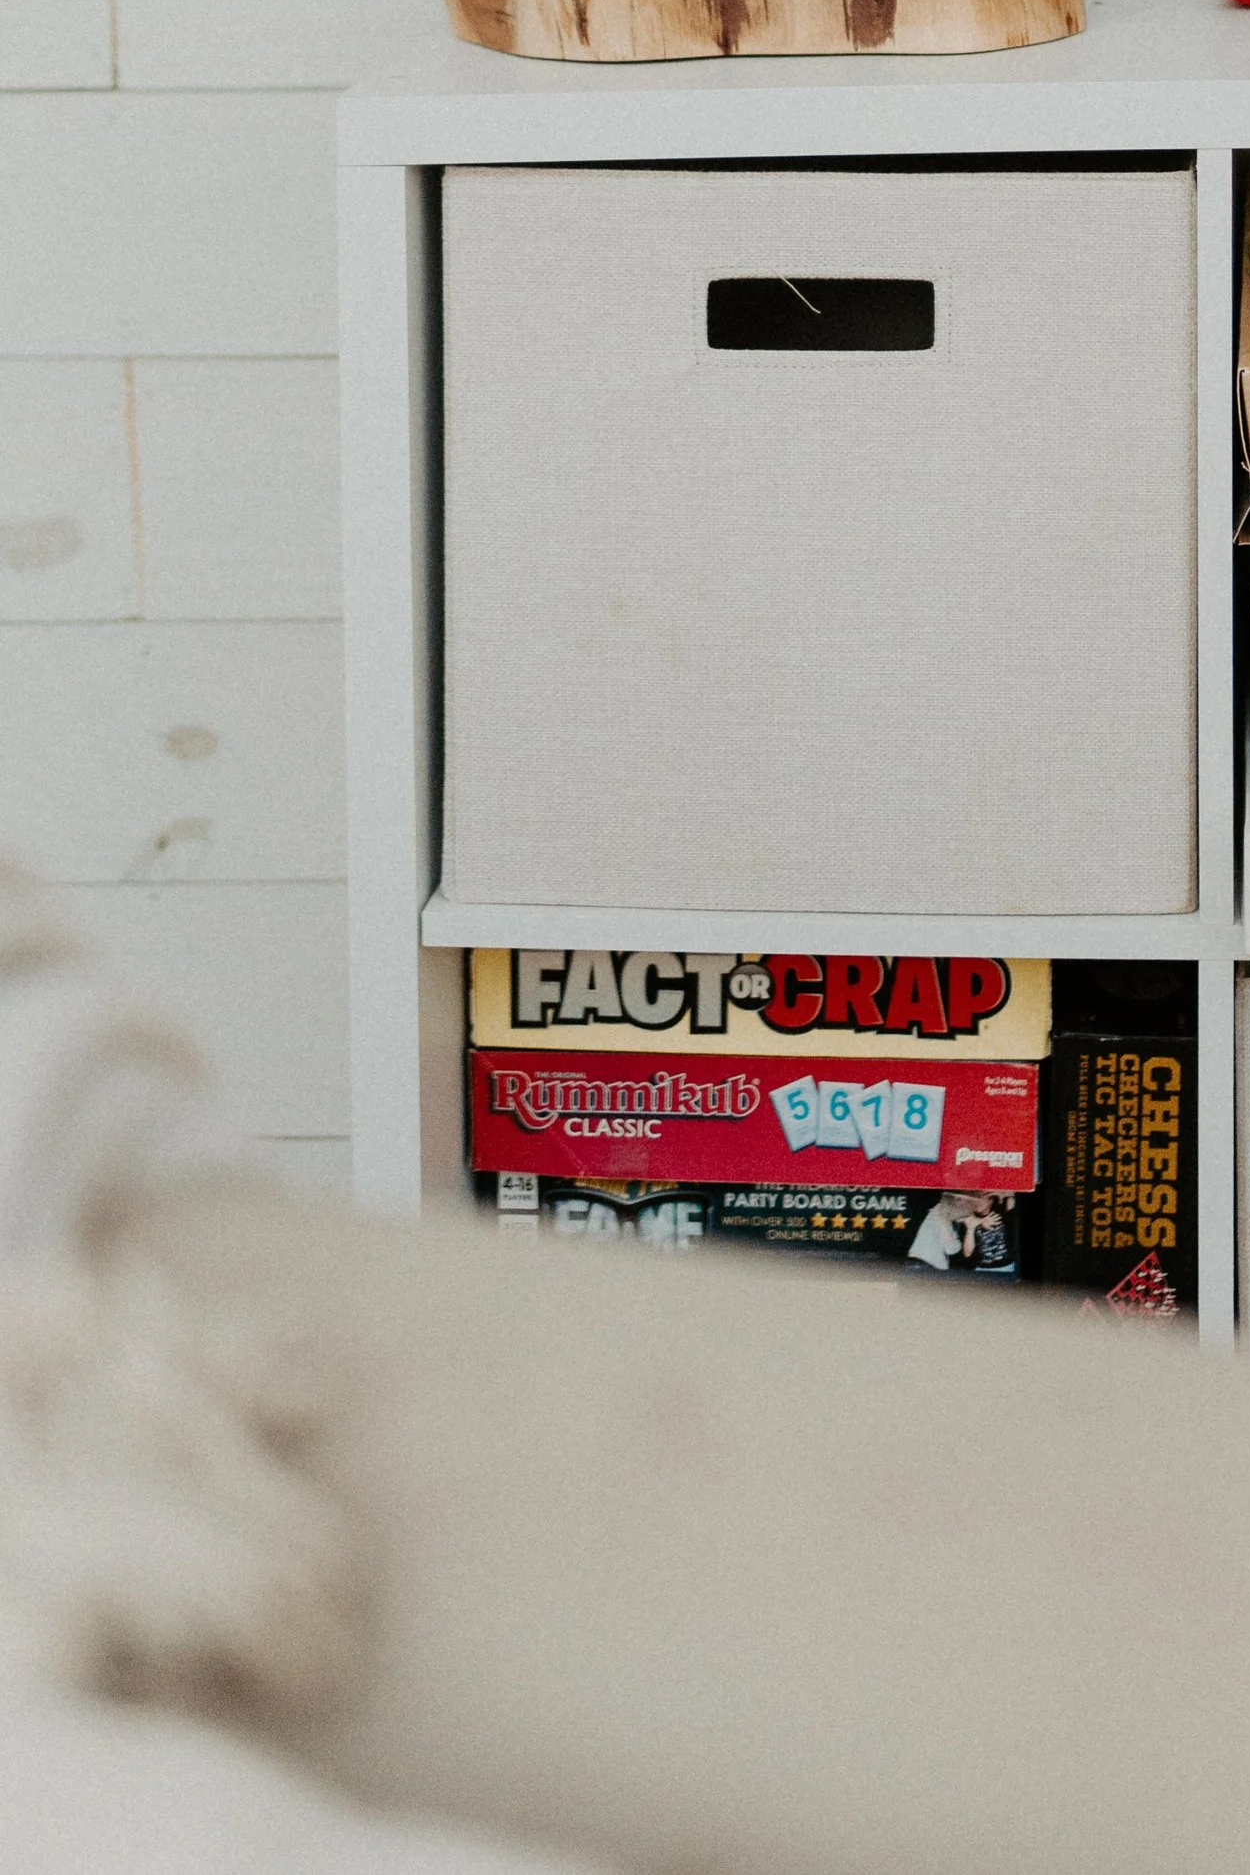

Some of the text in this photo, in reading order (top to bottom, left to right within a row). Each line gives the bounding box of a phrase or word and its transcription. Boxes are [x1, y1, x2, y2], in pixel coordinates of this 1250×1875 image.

[513, 949, 1007, 1036] FACT OR CRAP
[1078, 1053, 1089, 1082] FULL
[492, 1070, 760, 1130] Rummikub
[786, 1090, 928, 1130] 5 6 7 8
[564, 1118, 662, 1139] CLASSIC
[1075, 1130, 1087, 1170] INCHES
[1090, 1053, 1118, 1249] TIC TAC TOE
[1112, 1053, 1140, 1249] CHECKERS &
[1137, 1056, 1181, 1249] CHESS
[502, 1177, 534, 1192] 4-16
[723, 1193, 907, 1212] PARTY BOARD GAME
[751, 1216, 785, 1227] OVER
[766, 1229, 811, 1242] ONLINE
